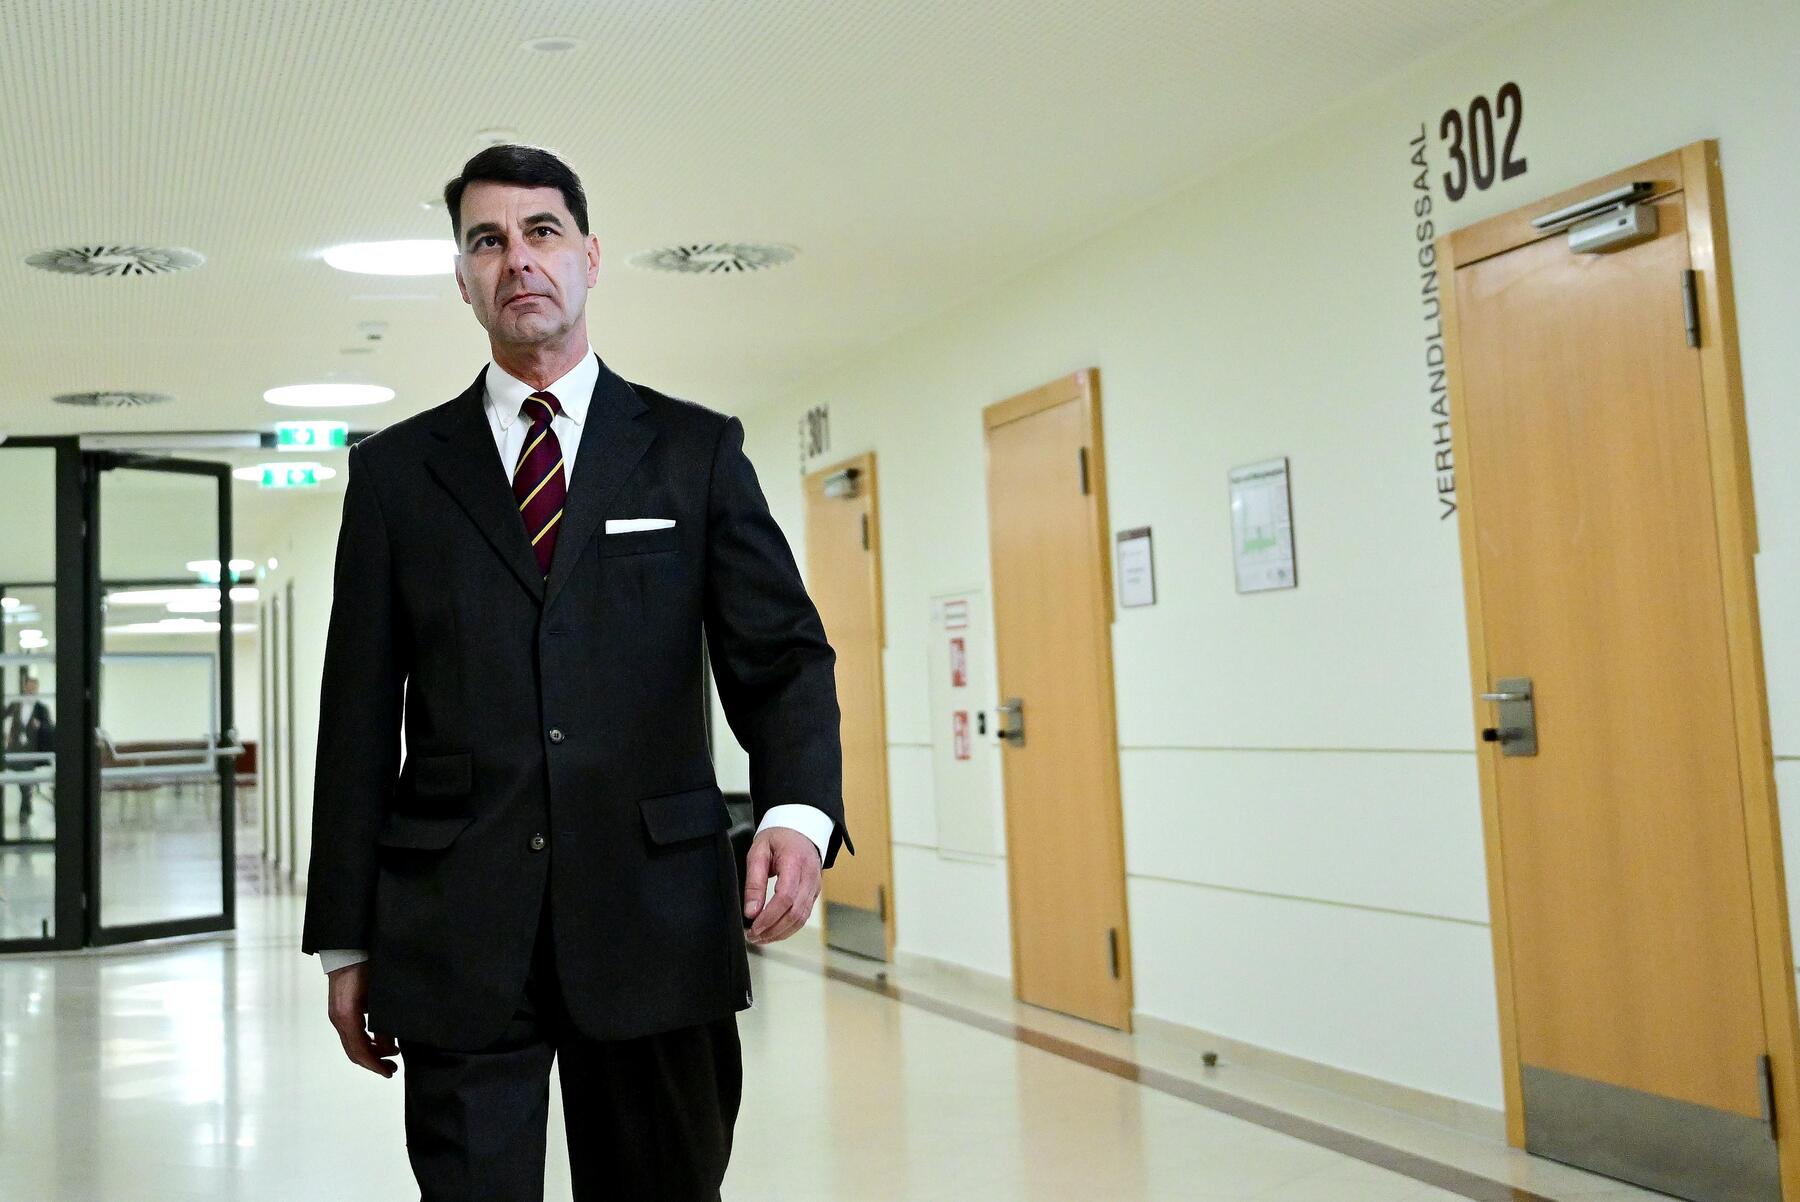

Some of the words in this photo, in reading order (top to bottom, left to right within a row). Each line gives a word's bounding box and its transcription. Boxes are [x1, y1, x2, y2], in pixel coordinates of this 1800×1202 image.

[1440, 82, 1527, 202] 302
[1410, 122, 1457, 520] VERHANDLUNGSSAAL
[808, 403, 829, 458] 301
